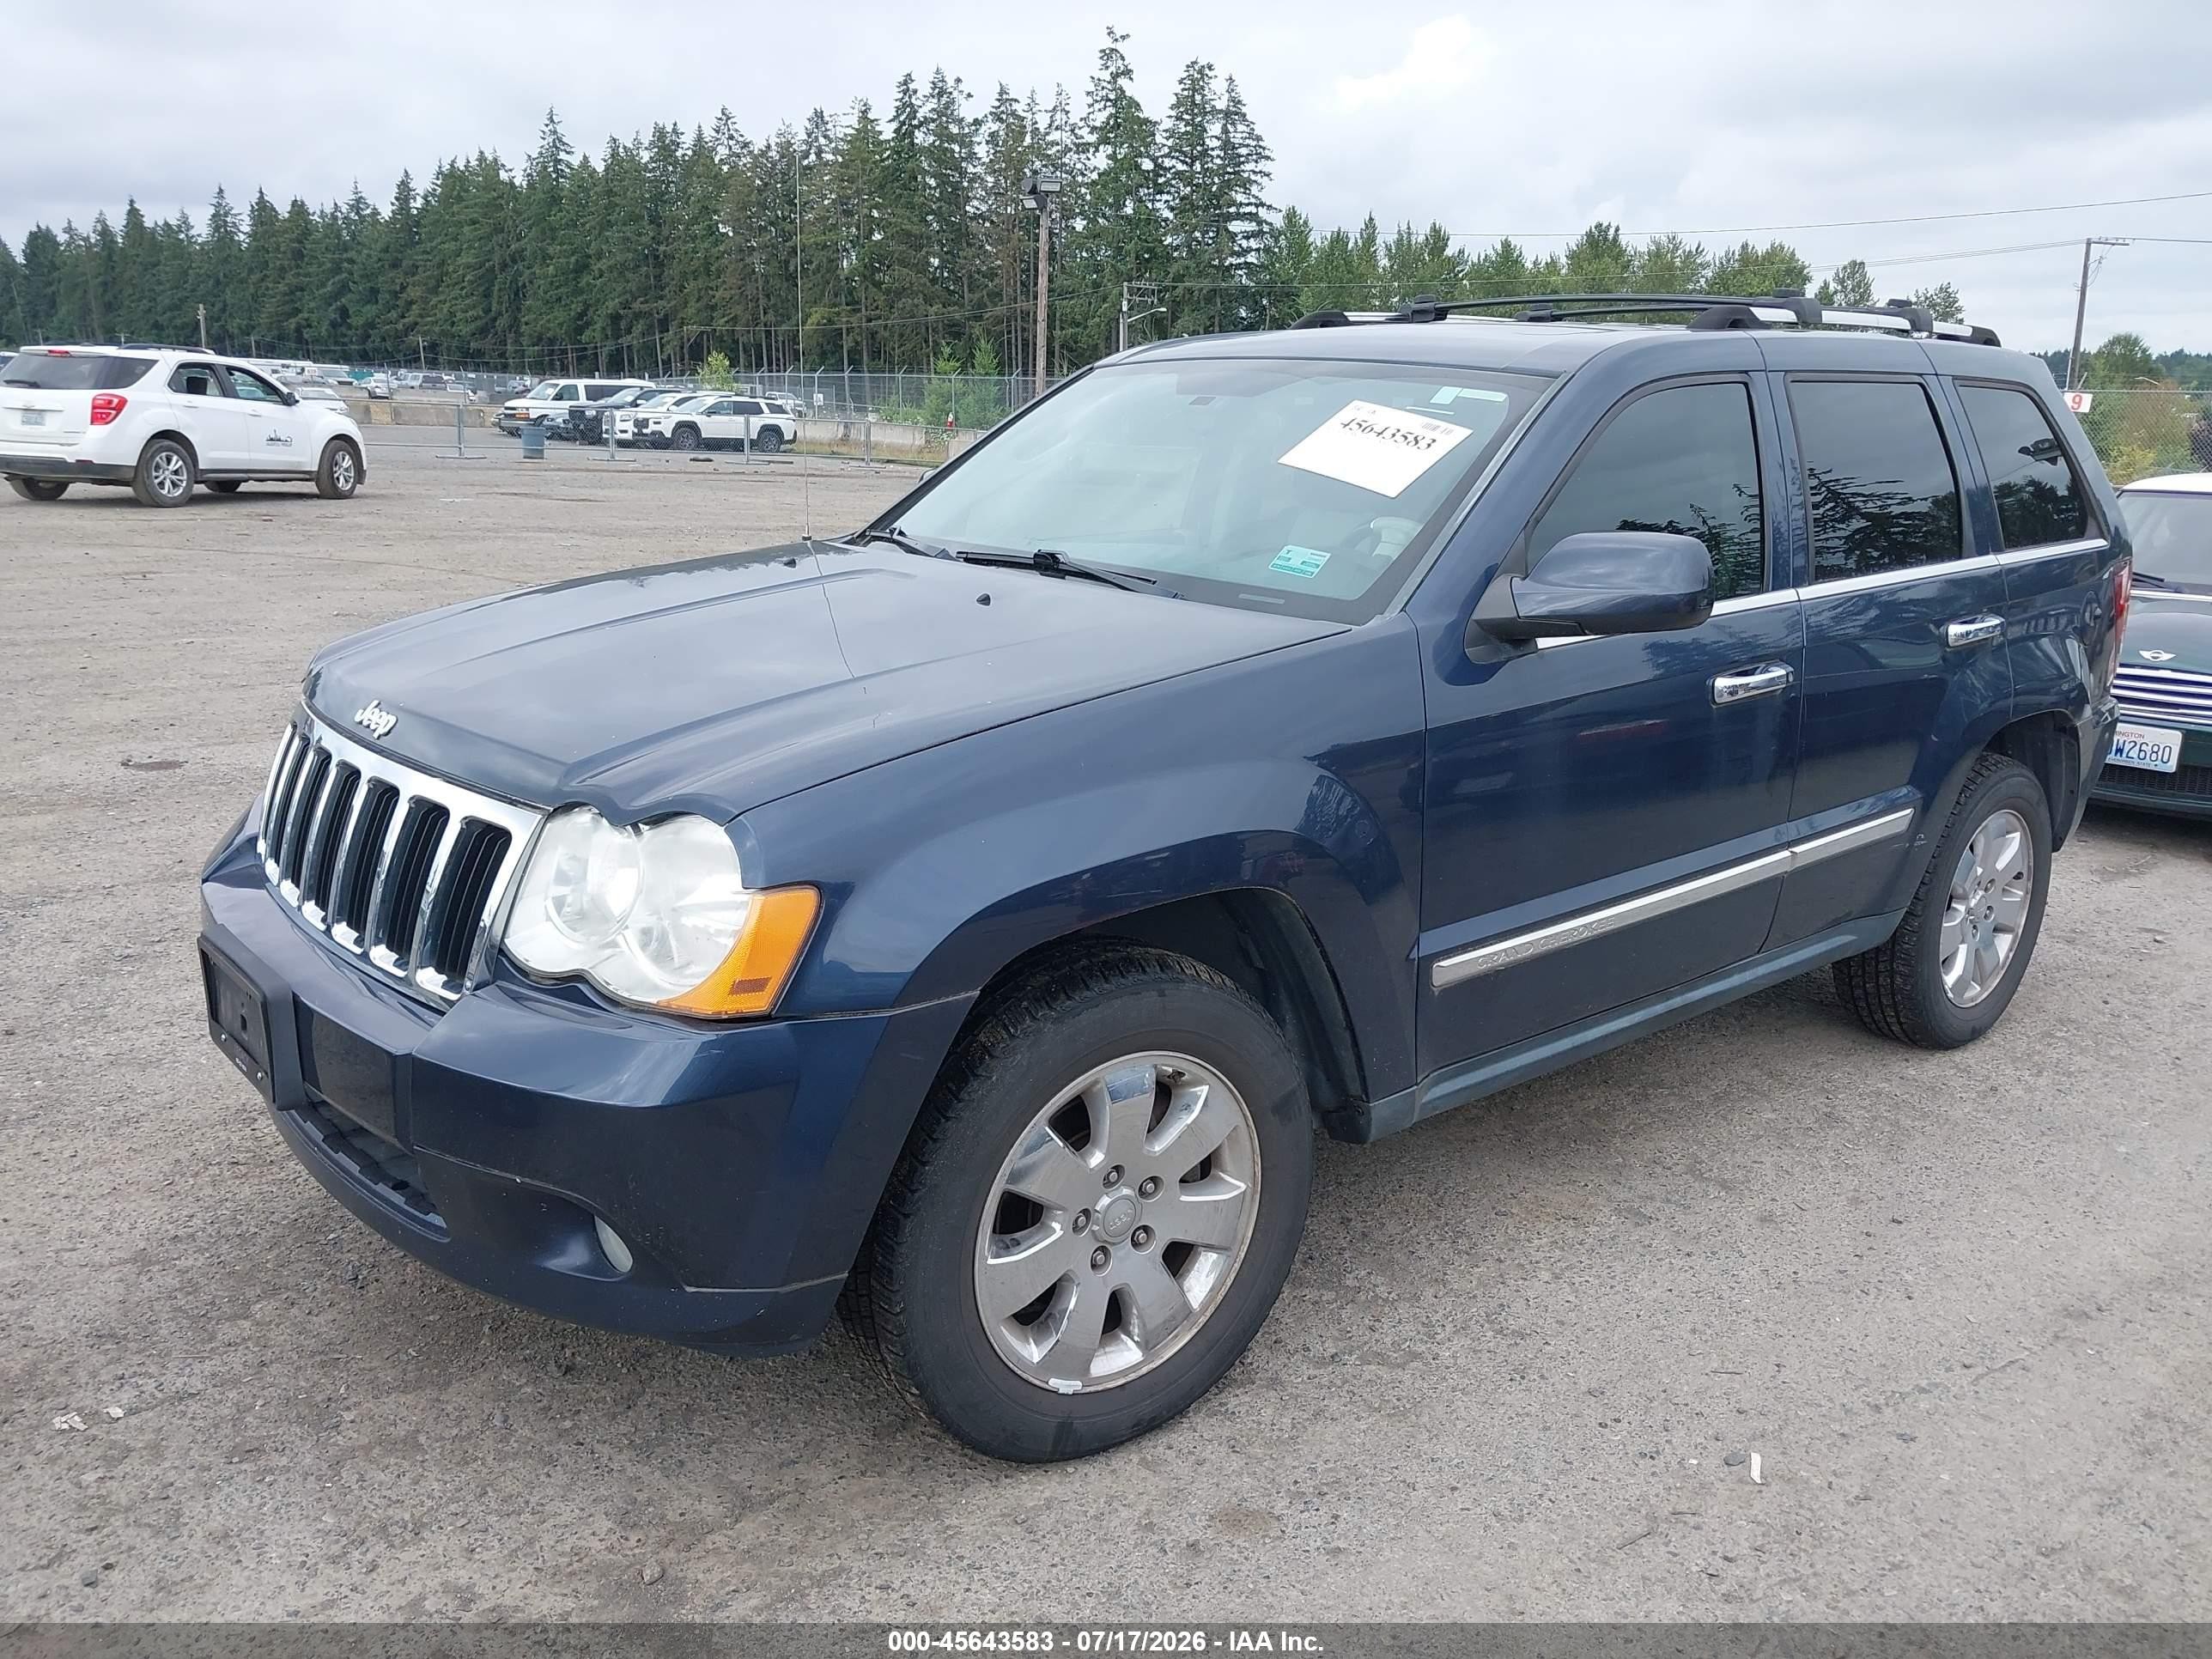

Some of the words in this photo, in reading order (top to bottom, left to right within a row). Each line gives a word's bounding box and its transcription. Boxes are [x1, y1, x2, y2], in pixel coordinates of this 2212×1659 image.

[2070, 393, 2082, 410] 9
[1340, 417, 1437, 450] 45643583
[354, 699, 398, 739] Jeep
[1476, 942, 1534, 969] GRAND
[1538, 917, 1616, 950] CHEROKEE
